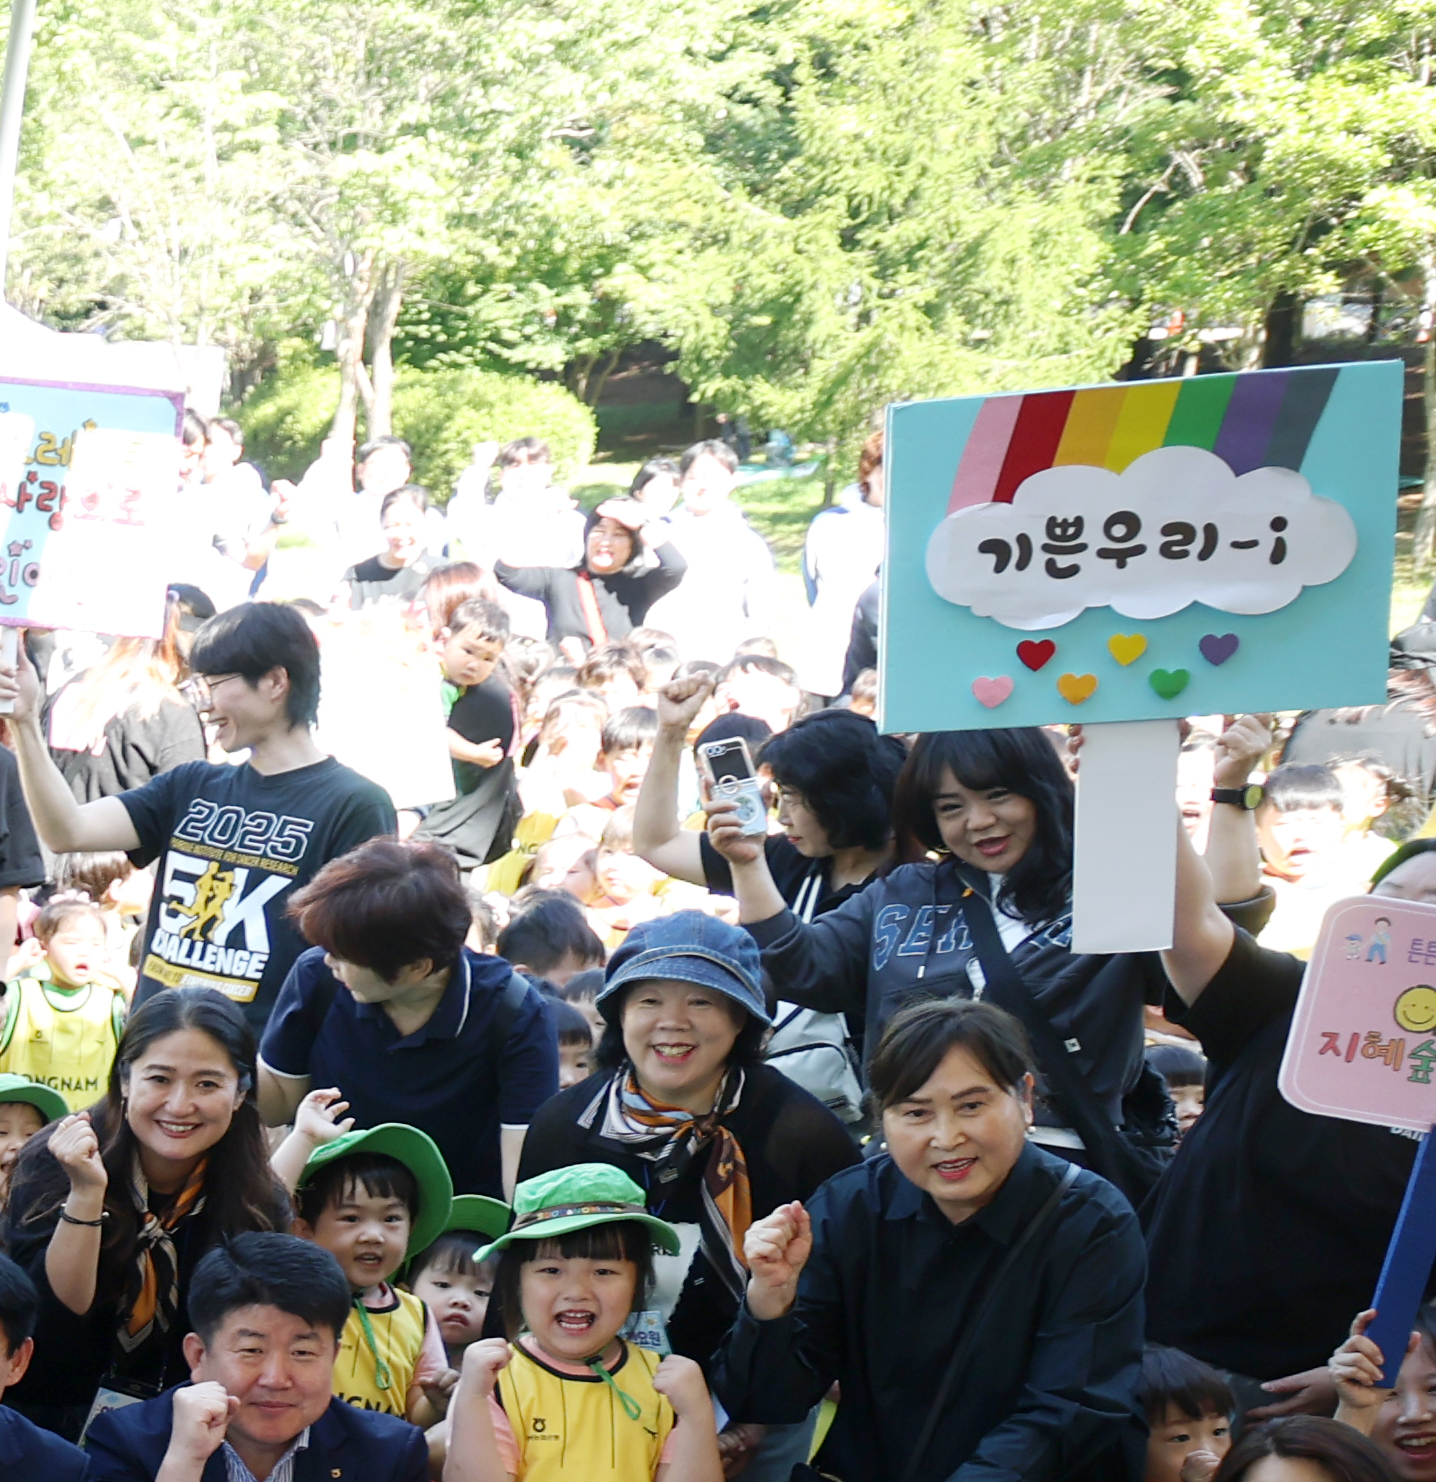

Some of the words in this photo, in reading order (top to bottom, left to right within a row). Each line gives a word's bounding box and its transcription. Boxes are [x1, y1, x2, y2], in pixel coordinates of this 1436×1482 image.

[173, 798, 314, 862] 2025
[159, 850, 292, 954] 5K
[150, 927, 270, 979] CHALLENGE
